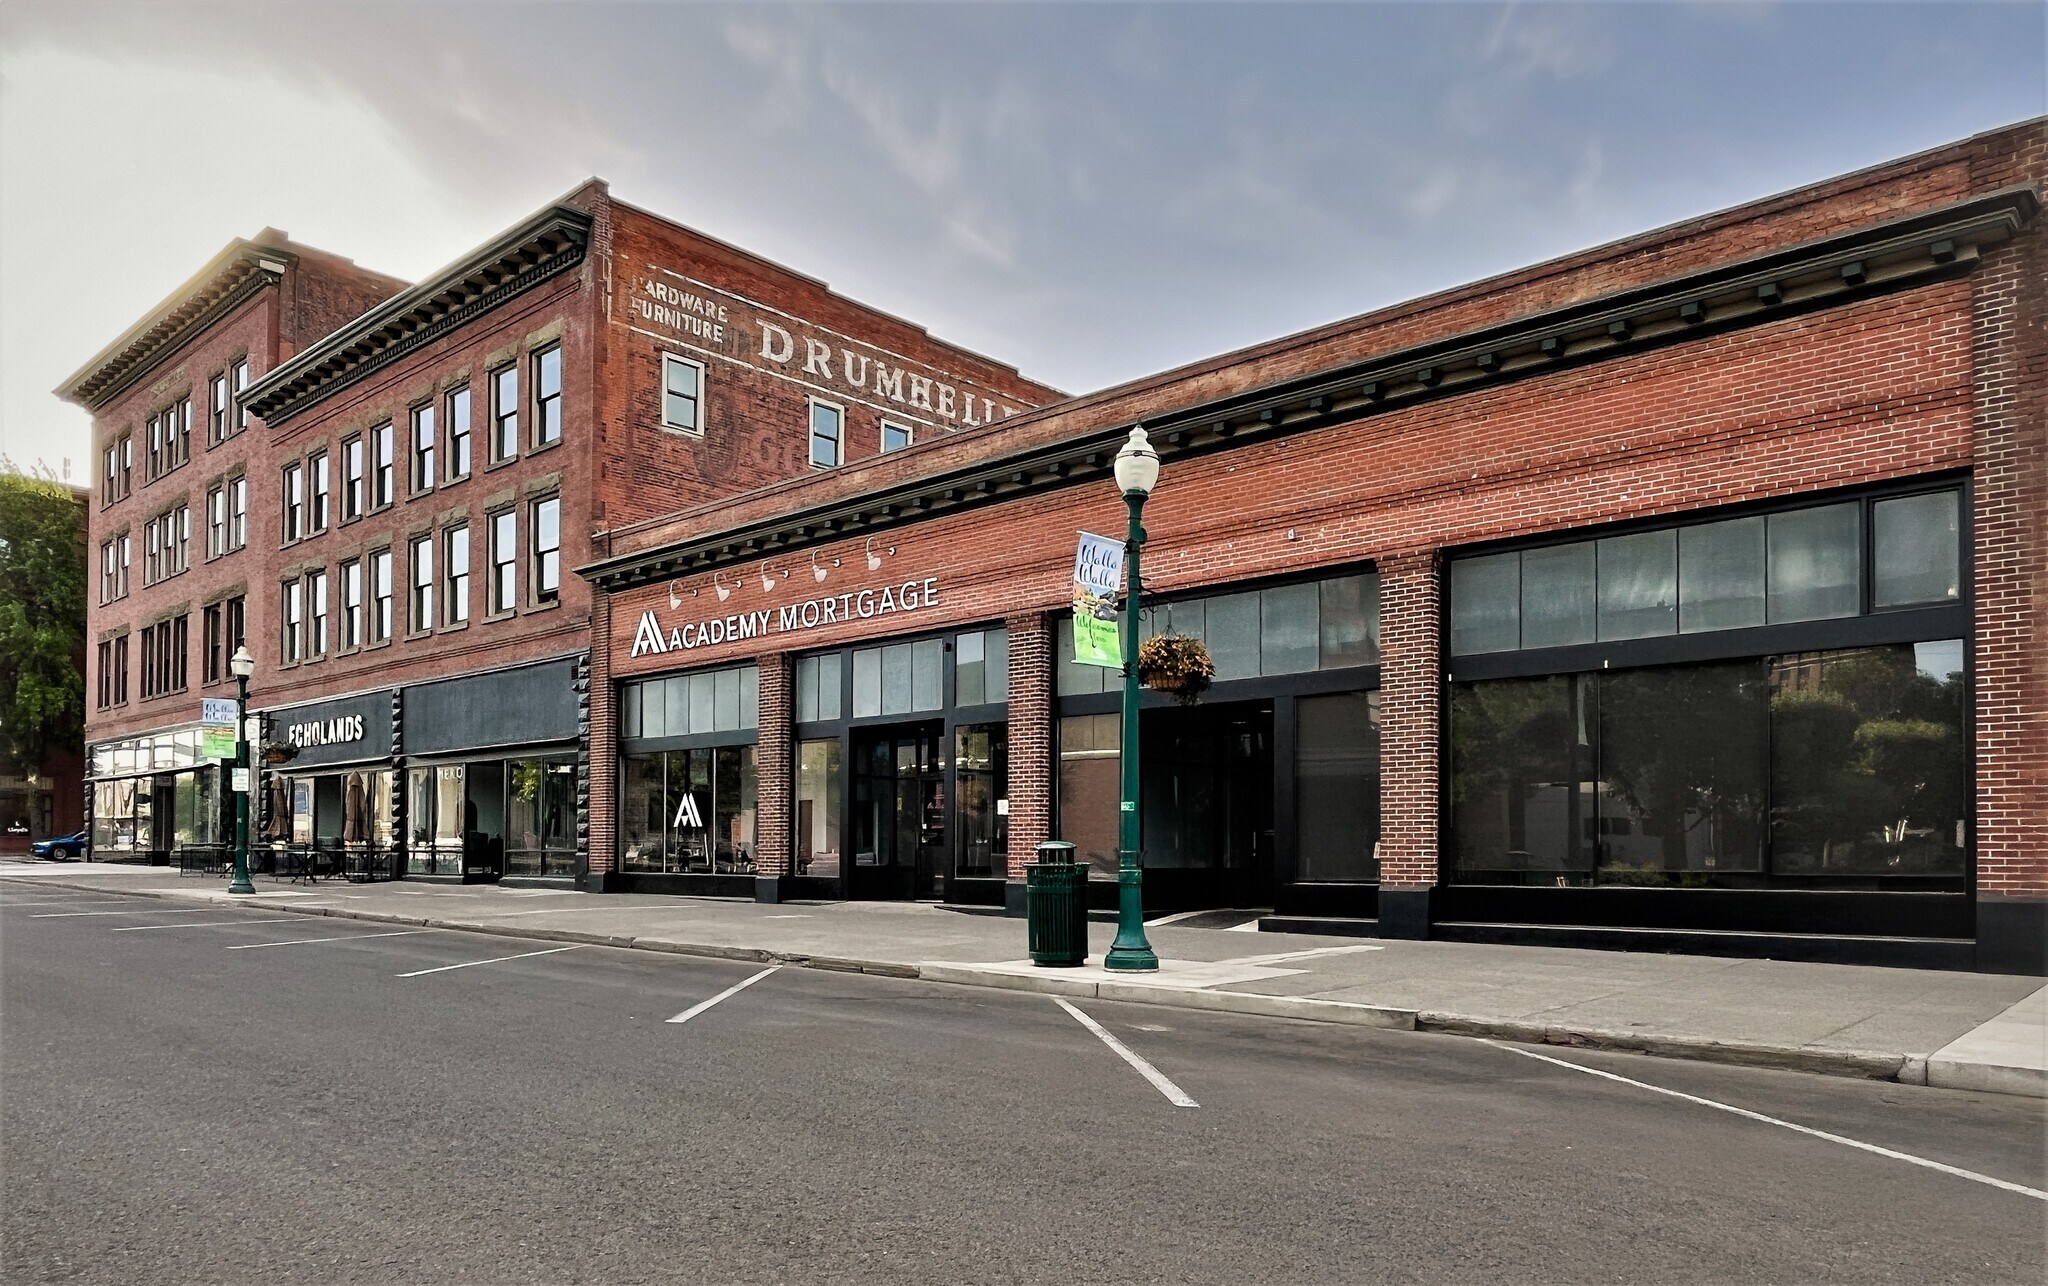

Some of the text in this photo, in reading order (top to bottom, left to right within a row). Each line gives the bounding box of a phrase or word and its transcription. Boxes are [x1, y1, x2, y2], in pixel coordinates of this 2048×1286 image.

[630, 295, 724, 344] FURNITURE
[755, 317, 1022, 427] DRUMHELL
[1079, 563, 1115, 588] Walla
[1082, 544, 1117, 570] Walla
[669, 608, 772, 651] ACADEMY
[778, 576, 940, 632] MORTGAGE
[288, 714, 363, 748] ECHOLANDS
